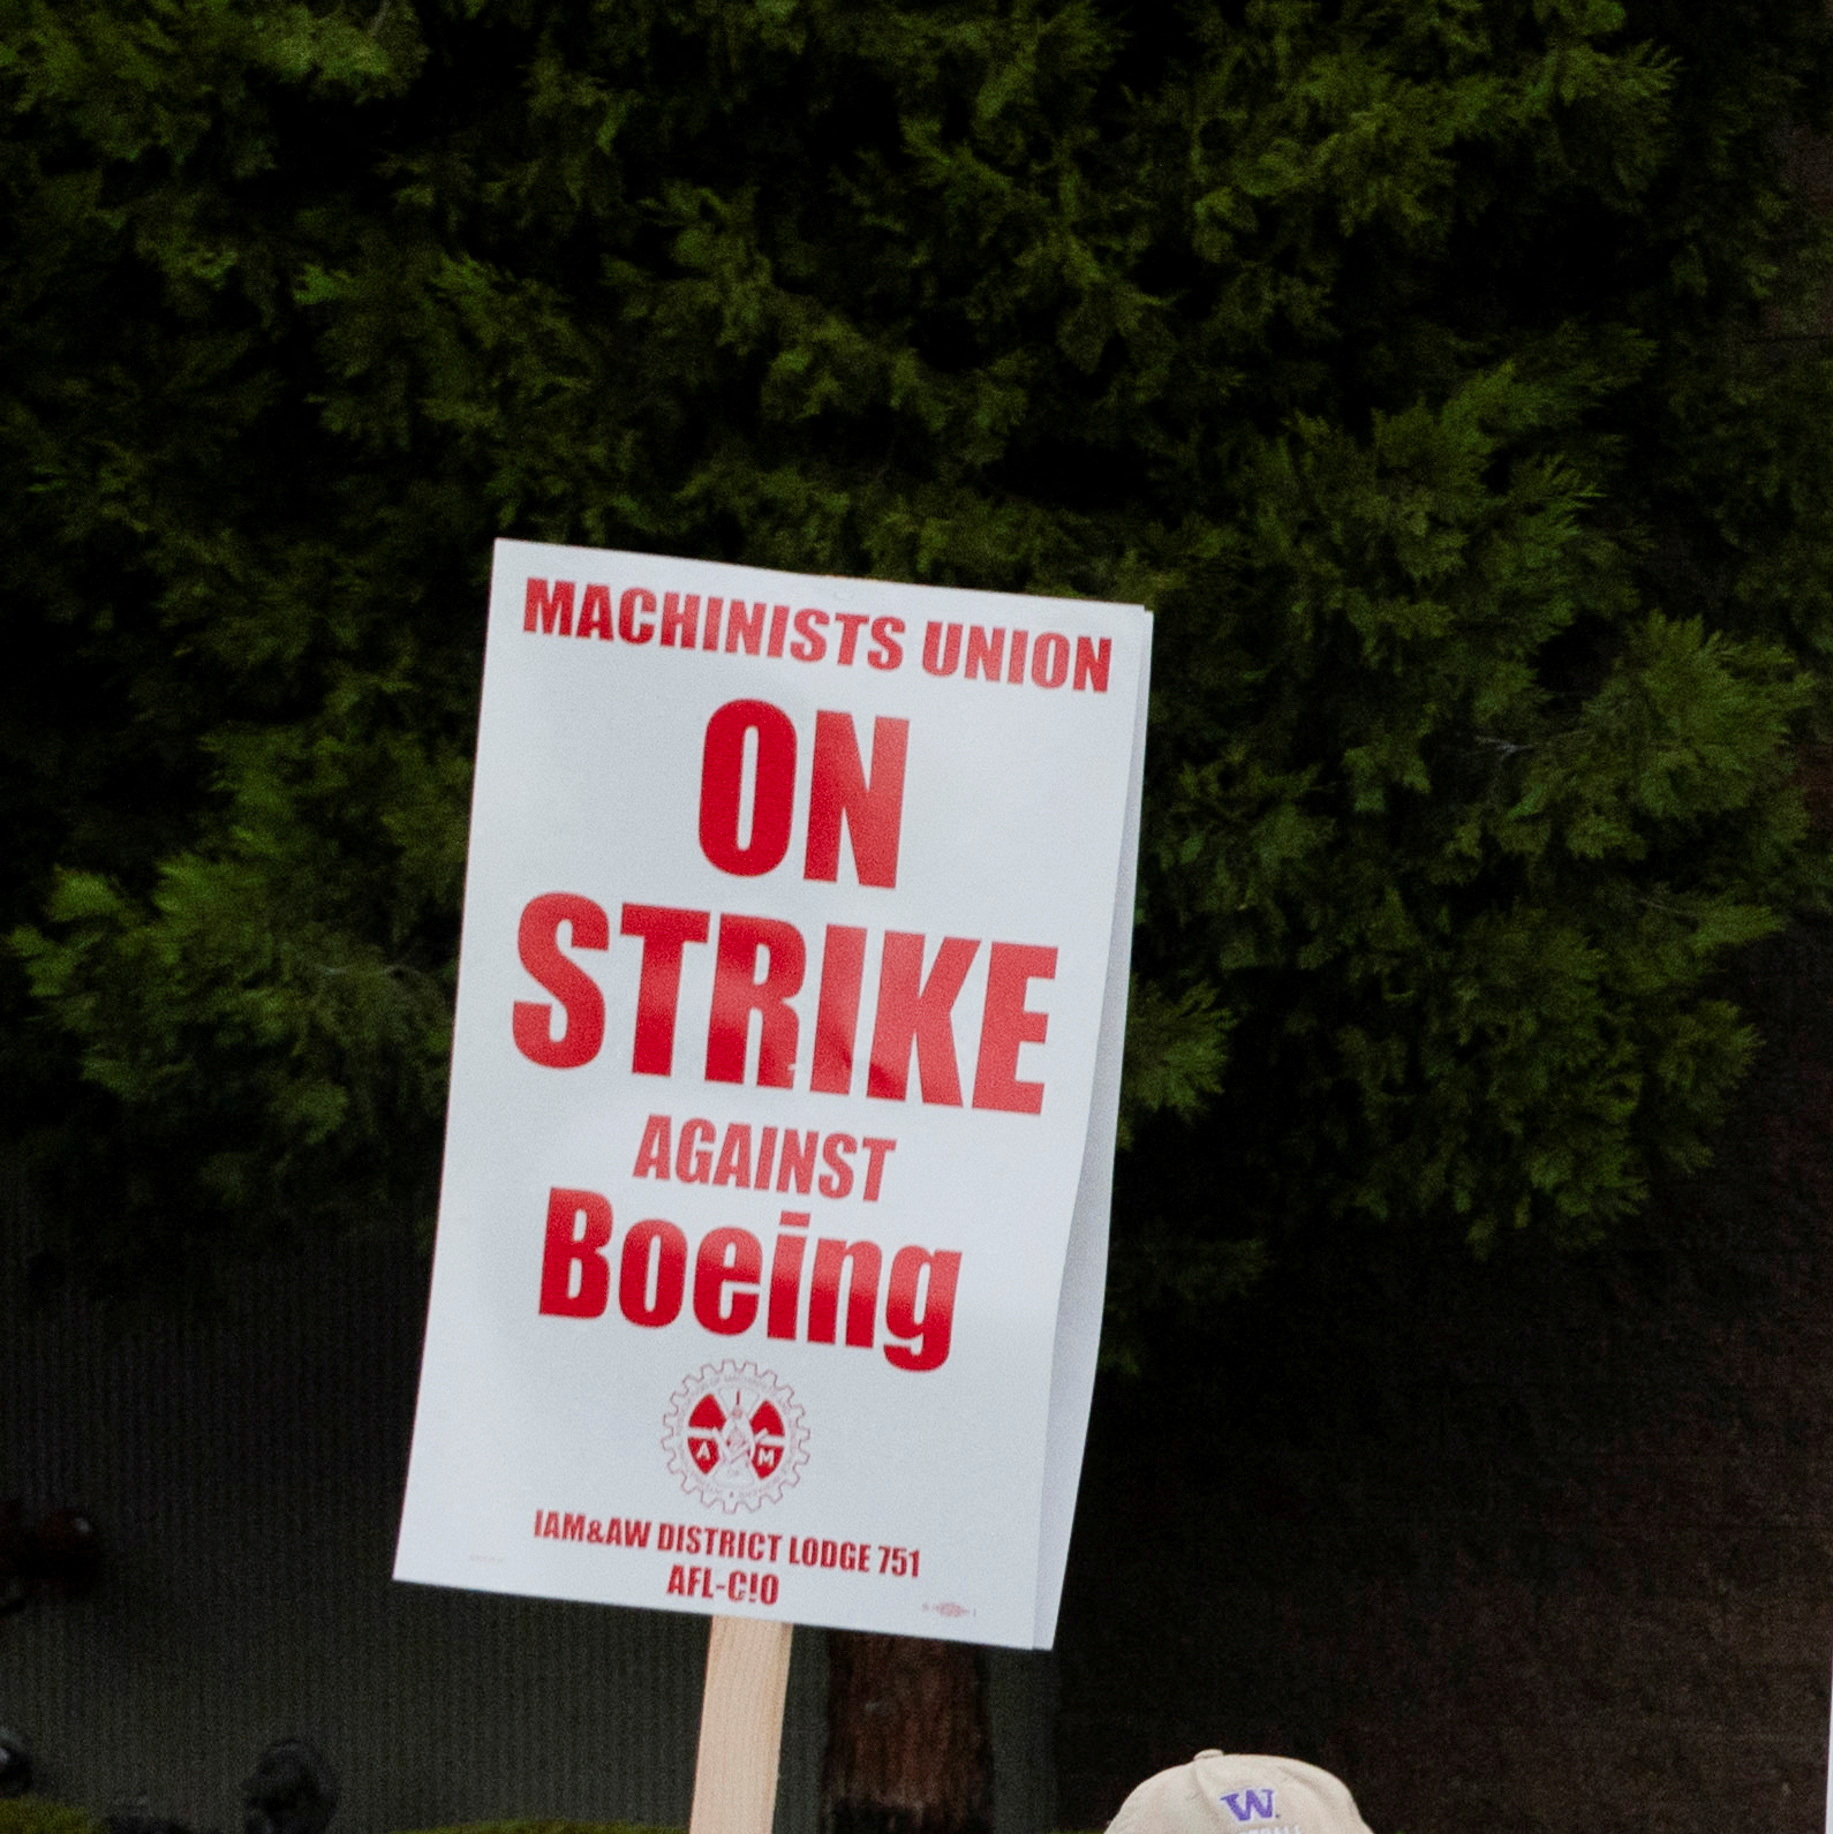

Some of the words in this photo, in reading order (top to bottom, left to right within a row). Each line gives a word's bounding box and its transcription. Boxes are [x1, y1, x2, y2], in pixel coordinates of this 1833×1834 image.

[523, 578, 906, 670] MACHINISTS
[922, 621, 1112, 693] UNION
[698, 698, 908, 889] ON
[512, 892, 1058, 1114] STRIKE
[633, 1115, 896, 1202] AGAINST
[539, 1187, 962, 1372] Boeing
[534, 1511, 651, 1549] IAM&AW
[657, 1523, 781, 1562] DISTRICT
[789, 1537, 870, 1572] LODGE
[877, 1545, 921, 1578] 751
[1220, 1788, 1273, 1821] W
